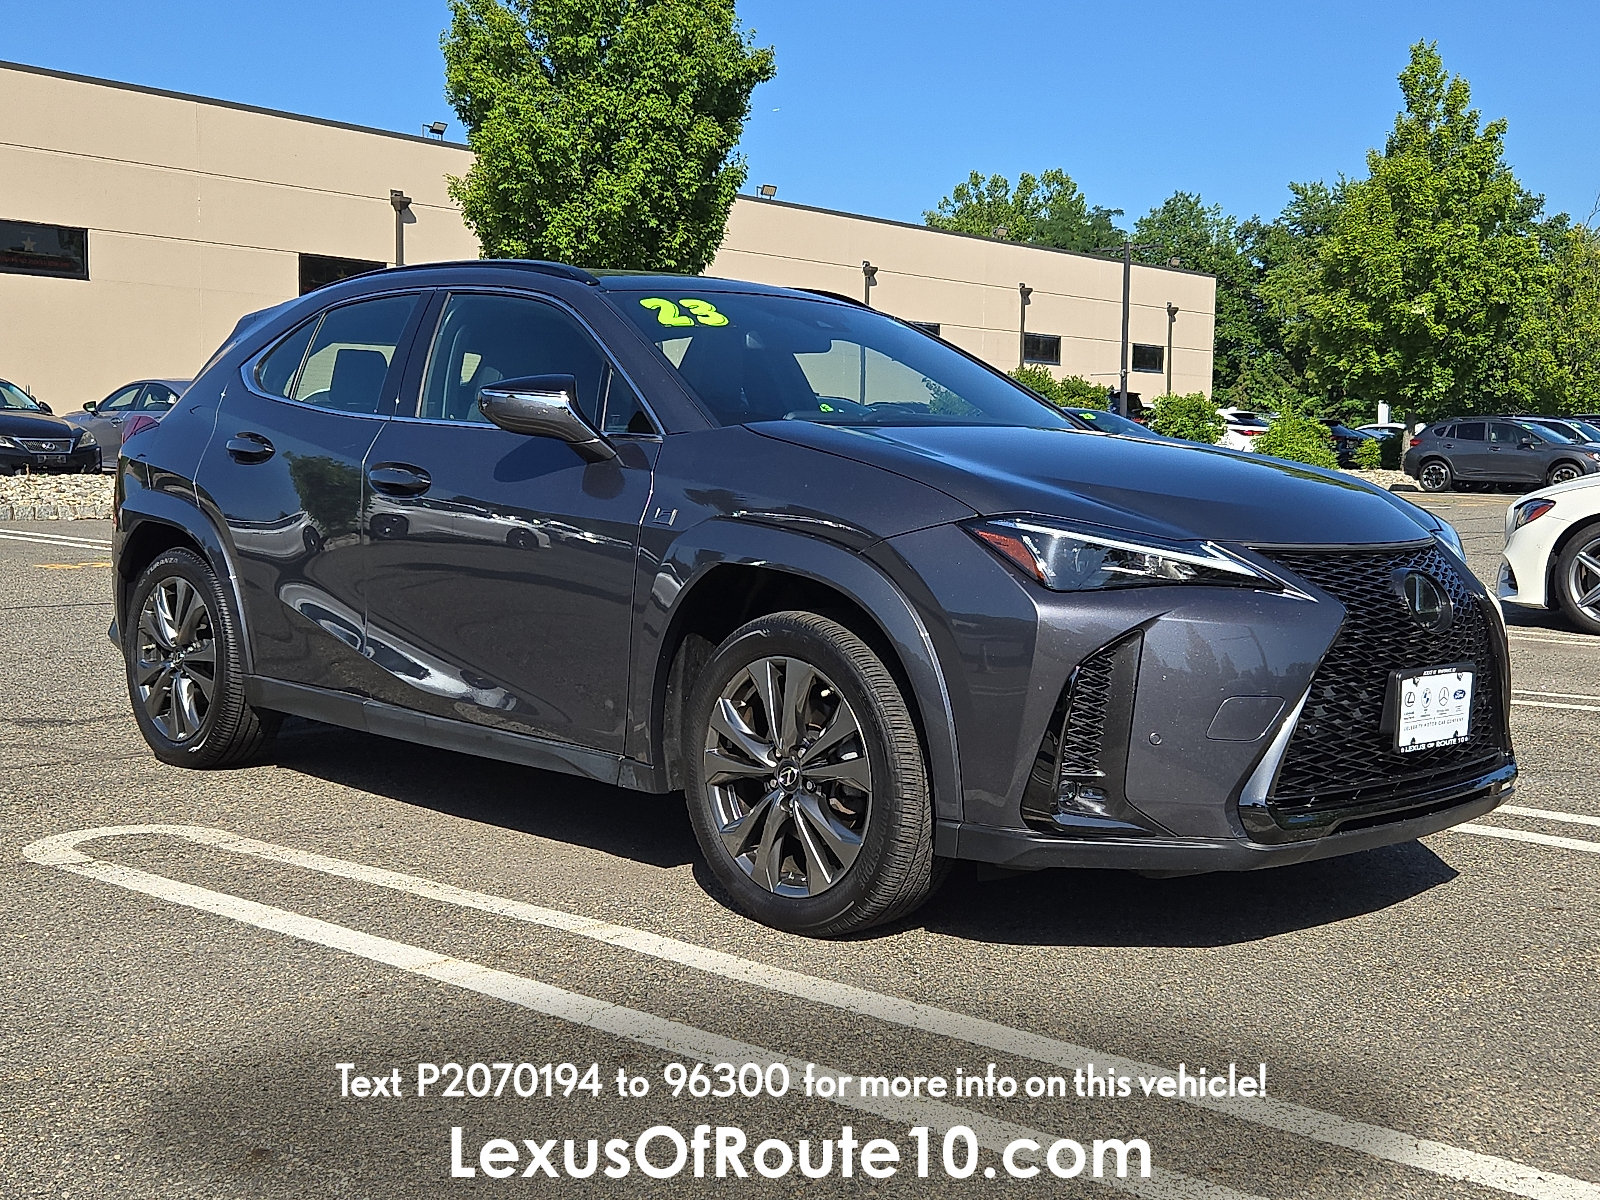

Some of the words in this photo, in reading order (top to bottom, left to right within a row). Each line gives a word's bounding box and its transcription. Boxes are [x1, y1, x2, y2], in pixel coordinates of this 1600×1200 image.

[639, 298, 730, 327] 23
[1405, 744, 1425, 752] LEXUS
[1436, 739, 1457, 748] ROUTE
